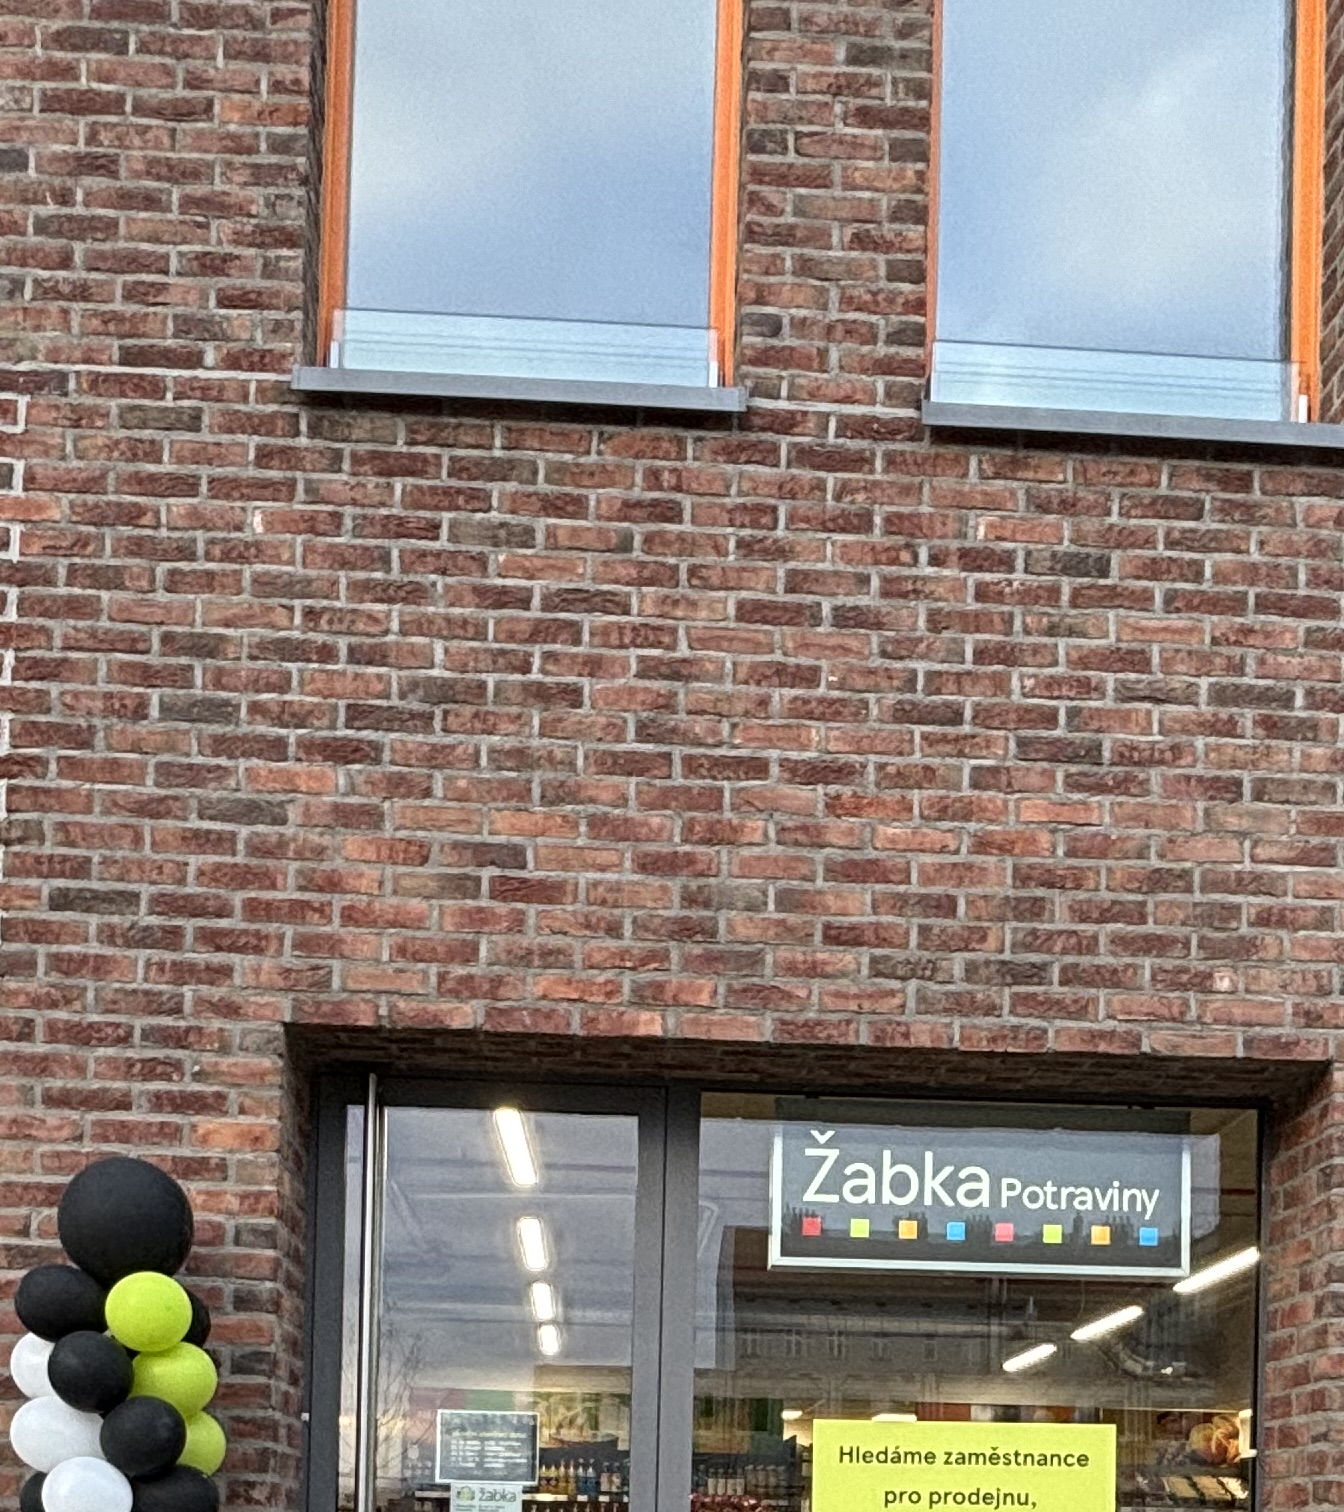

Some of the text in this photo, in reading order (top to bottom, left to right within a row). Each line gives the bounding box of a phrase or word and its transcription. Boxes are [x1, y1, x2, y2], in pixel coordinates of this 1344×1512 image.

[802, 1130, 1160, 1220] Žabka Potraviny
[838, 1445, 1090, 1468] Hledáme zaměstnance
[884, 1486, 1038, 1510] pro prodejnu,
